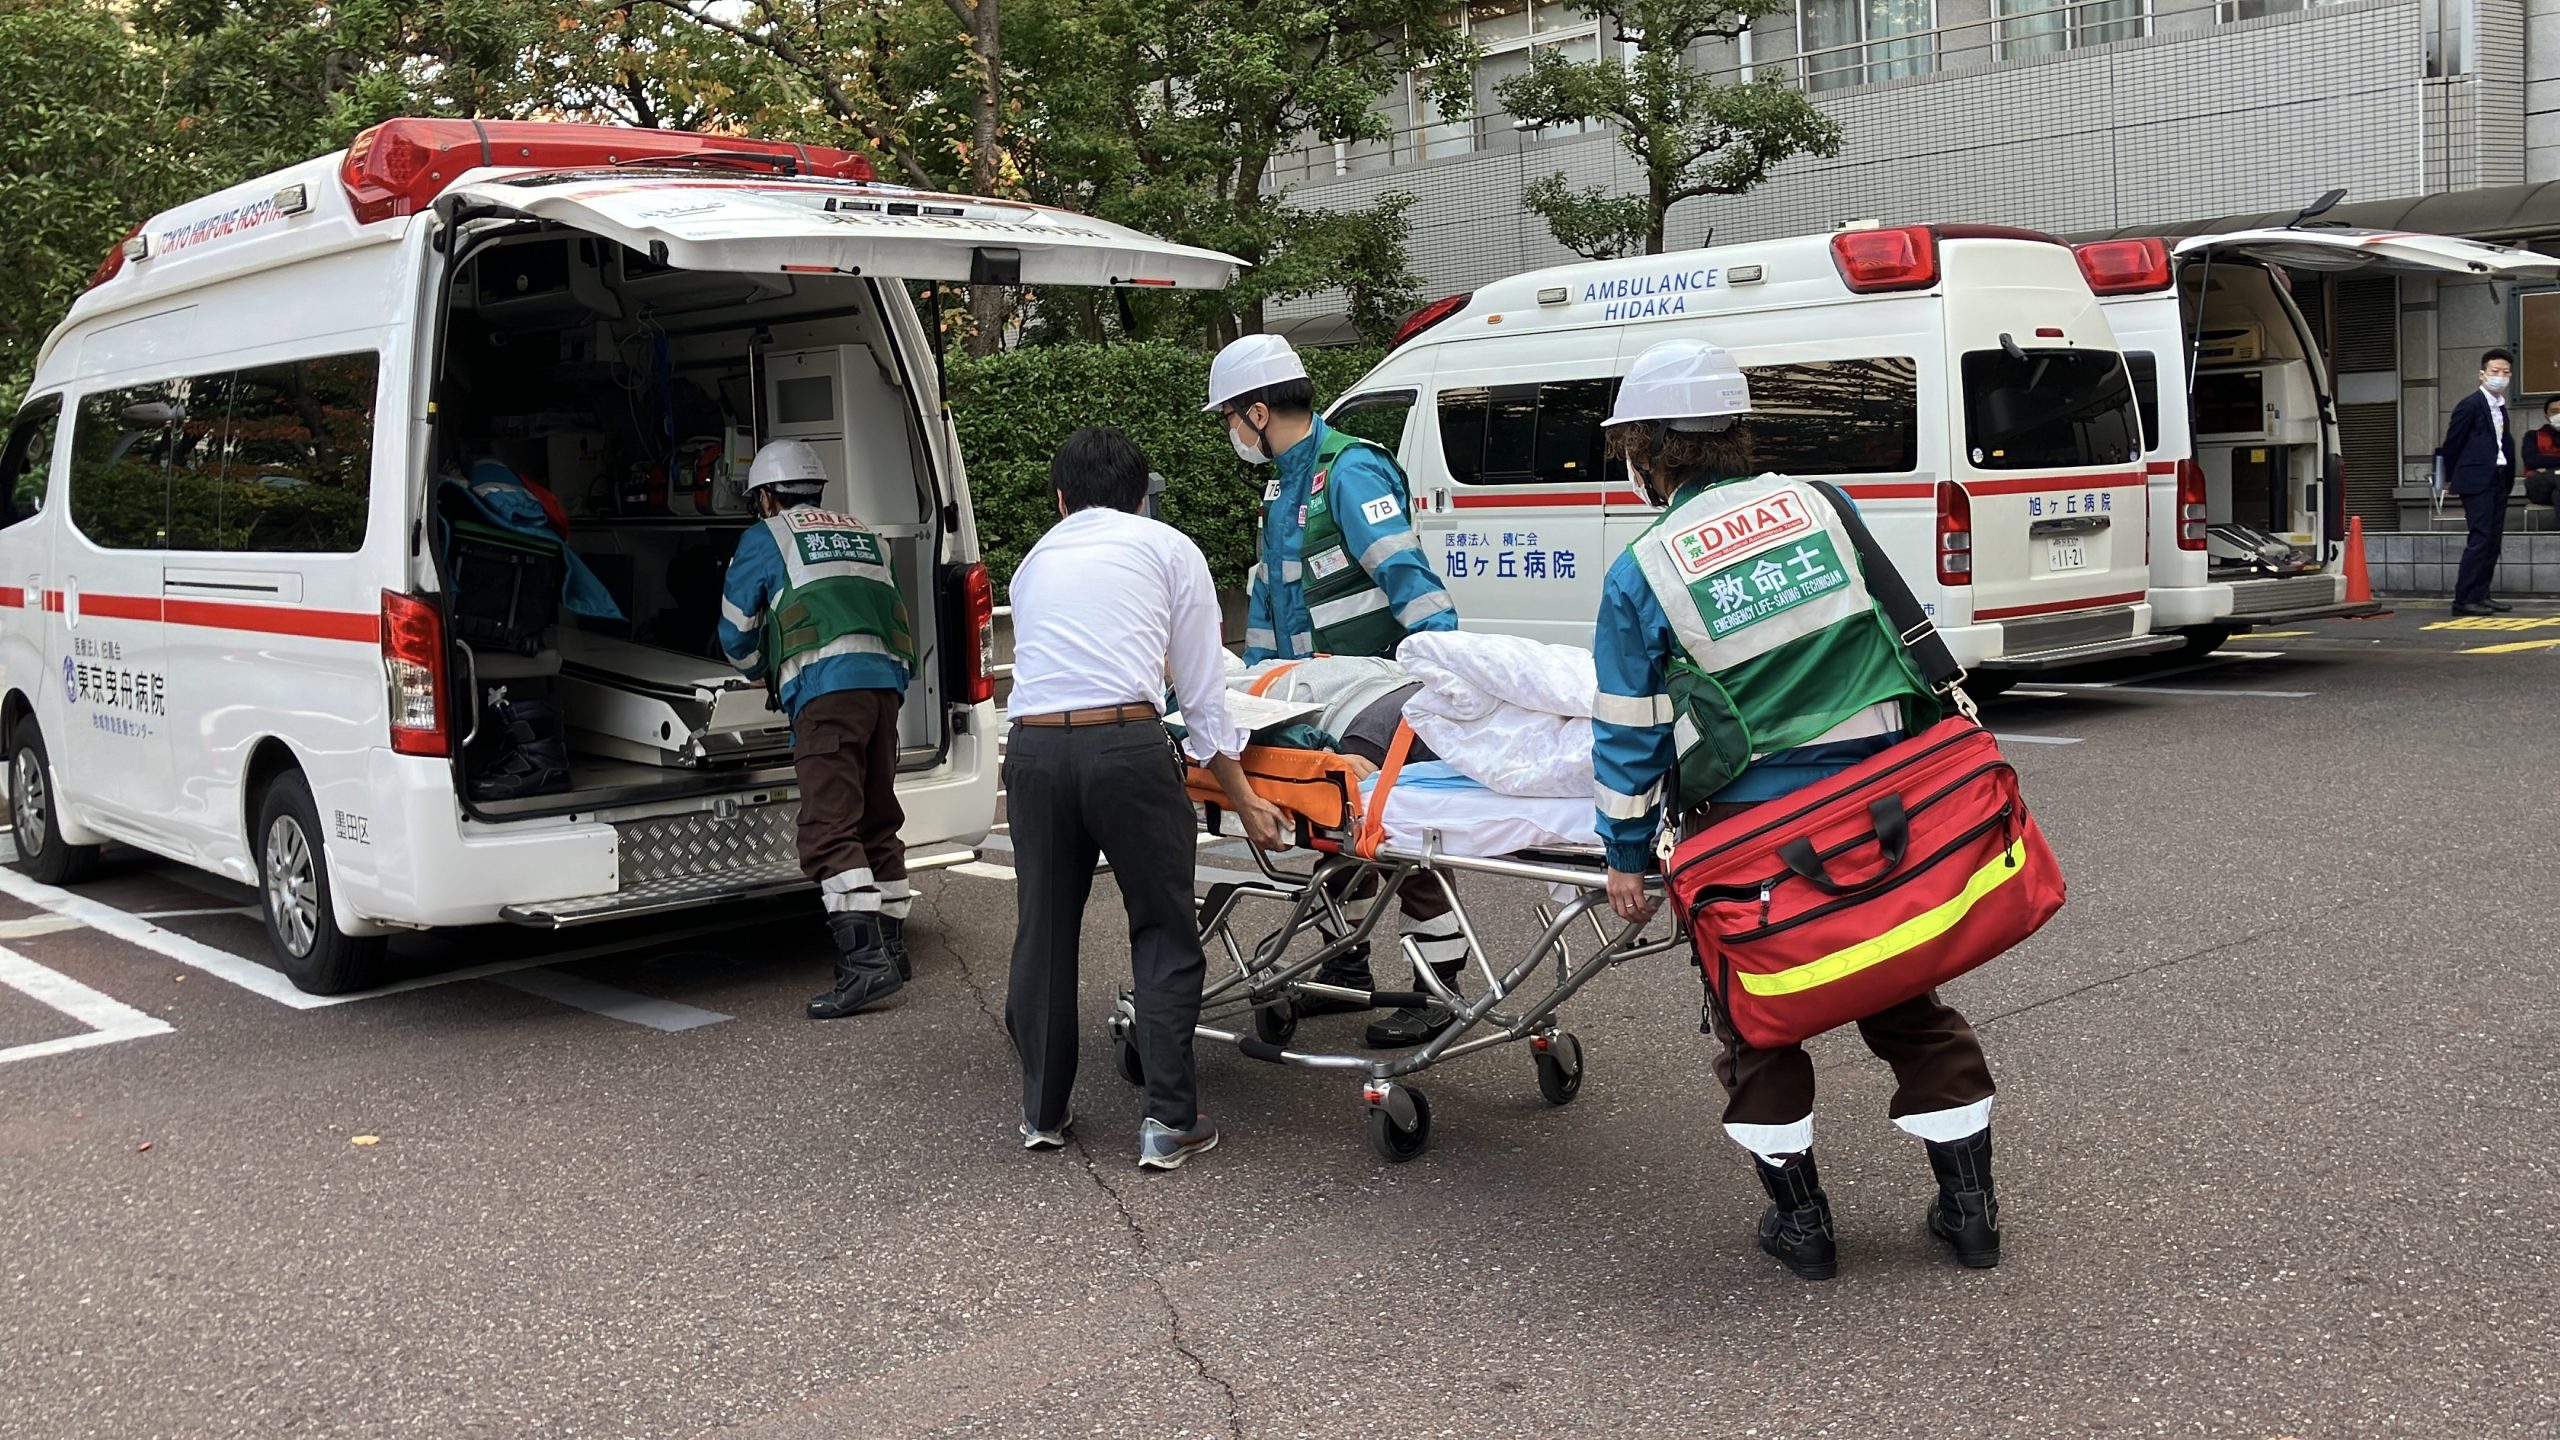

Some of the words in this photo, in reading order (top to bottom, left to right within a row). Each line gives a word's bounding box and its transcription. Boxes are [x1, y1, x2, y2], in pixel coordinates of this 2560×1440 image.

[157, 225, 191, 256] TOKYO
[189, 209, 239, 246] HIKIFUNE
[236, 199, 285, 232] HOSPI
[1584, 269, 1718, 301] AMBULANCE
[1605, 296, 1685, 320] HIDAKA
[1369, 500, 1393, 519] 7B
[2029, 492, 2111, 516] 旭ヶ丘病院
[1445, 533, 1490, 546] 医療法人
[1698, 498, 1793, 551] DMAT
[804, 533, 871, 551] 救命士
[1446, 550, 1575, 579] 旭ヶ丘病院
[1708, 545, 1825, 614] 救命士
[1713, 606, 1756, 633] EMERGENCY
[1755, 586, 1801, 616] LIFE-SAVING
[1801, 569, 1843, 596] TECHNICIAN
[77, 662, 165, 716] 東京曳舟病院
[335, 810, 371, 845] 墨田区
